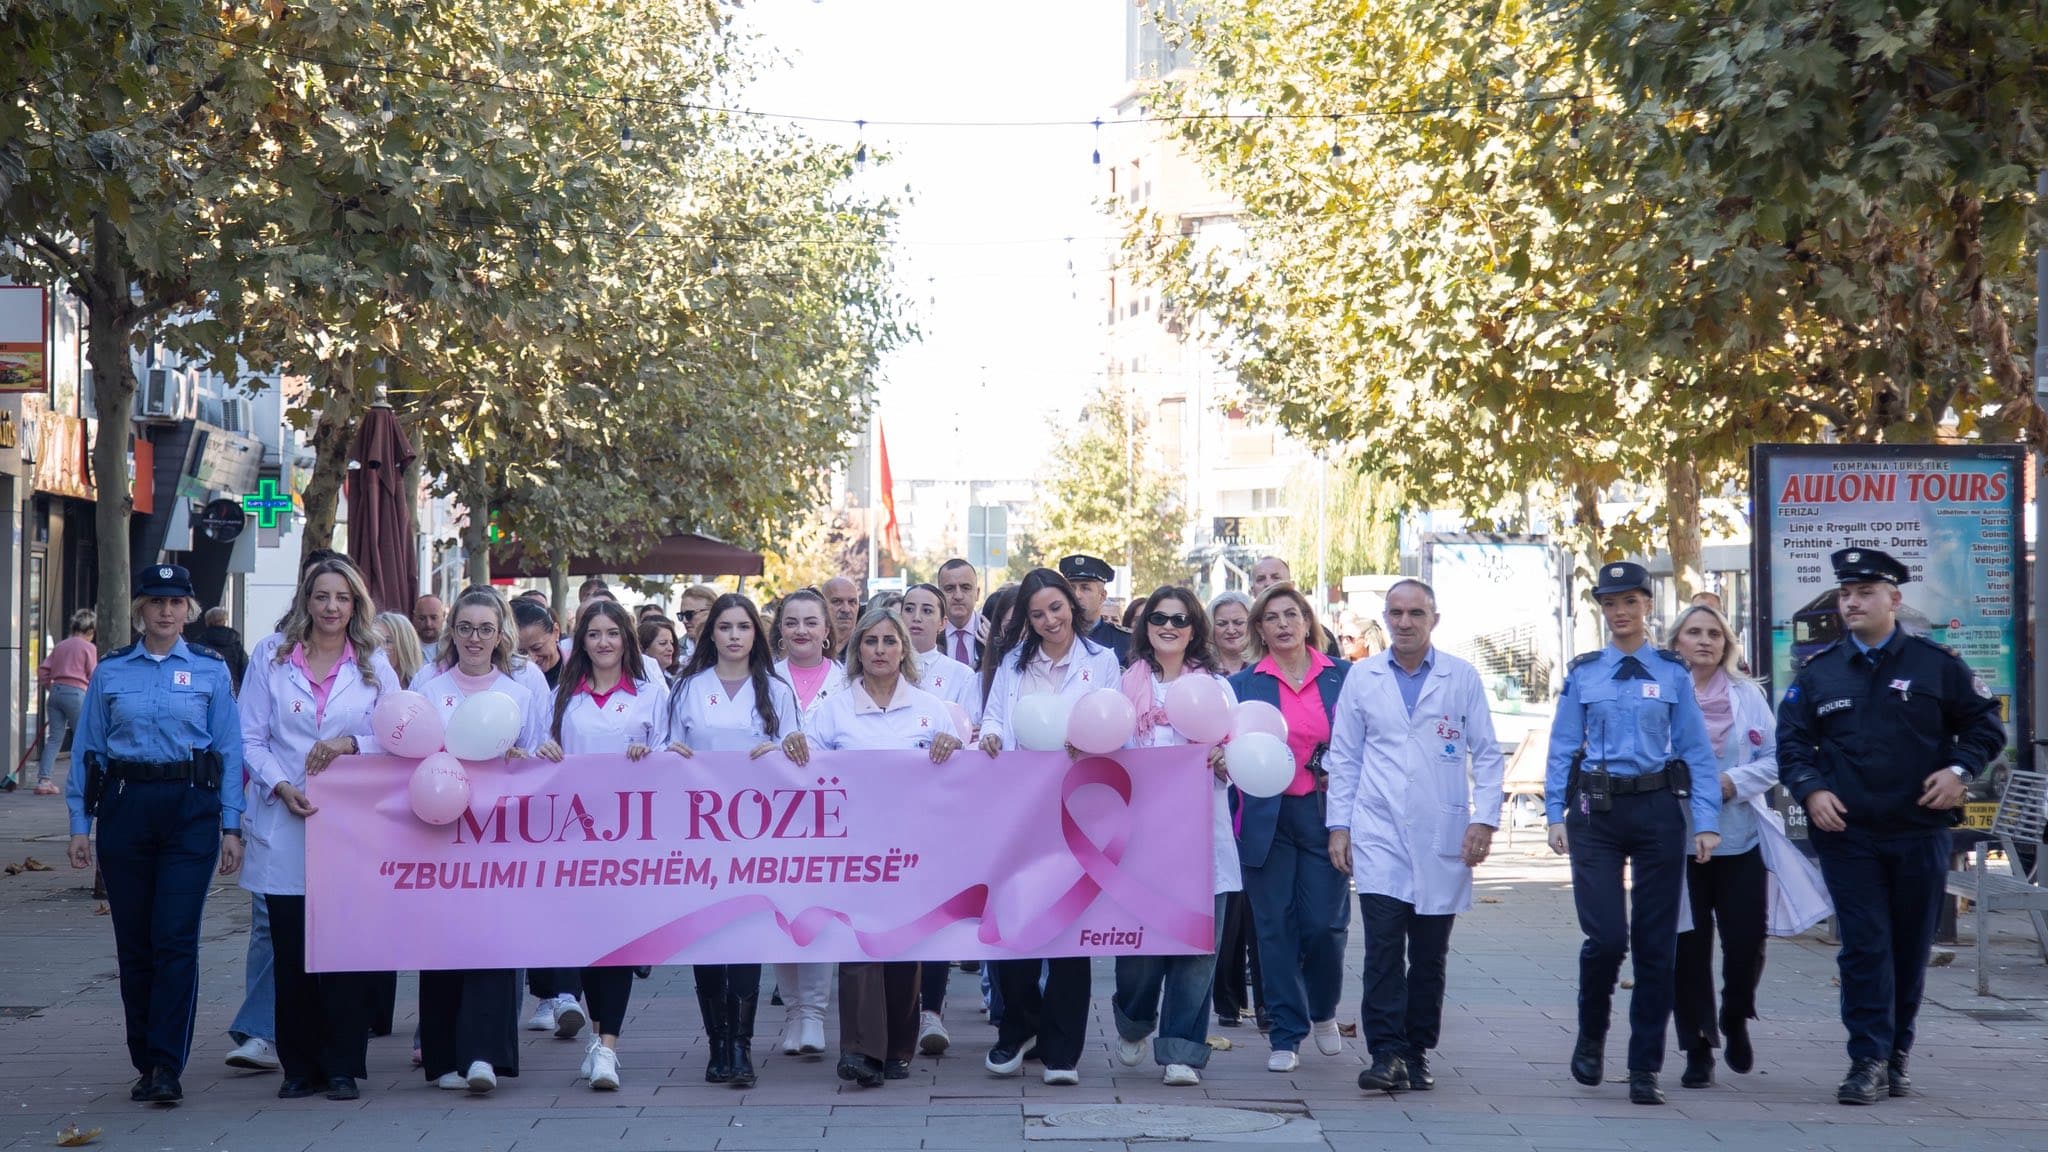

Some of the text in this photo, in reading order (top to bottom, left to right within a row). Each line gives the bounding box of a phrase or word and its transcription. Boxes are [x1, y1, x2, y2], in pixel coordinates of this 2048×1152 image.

[1832, 461, 1950, 472] KOMPANIA TURISTIKE
[1780, 472, 2008, 504] AULONI TOURS
[1778, 508, 1820, 517] FERIZAJ
[1826, 523, 1867, 534] Rregullt
[1783, 537, 1833, 548] Prishtinë
[1891, 536, 1928, 547] Durrës
[1820, 699, 1852, 715] POLICE
[452, 776, 848, 845] MUAJI ROZË
[536, 860, 546, 888] I
[554, 851, 718, 890] HERSHËM,
[1079, 926, 1144, 949] Ferizaj
